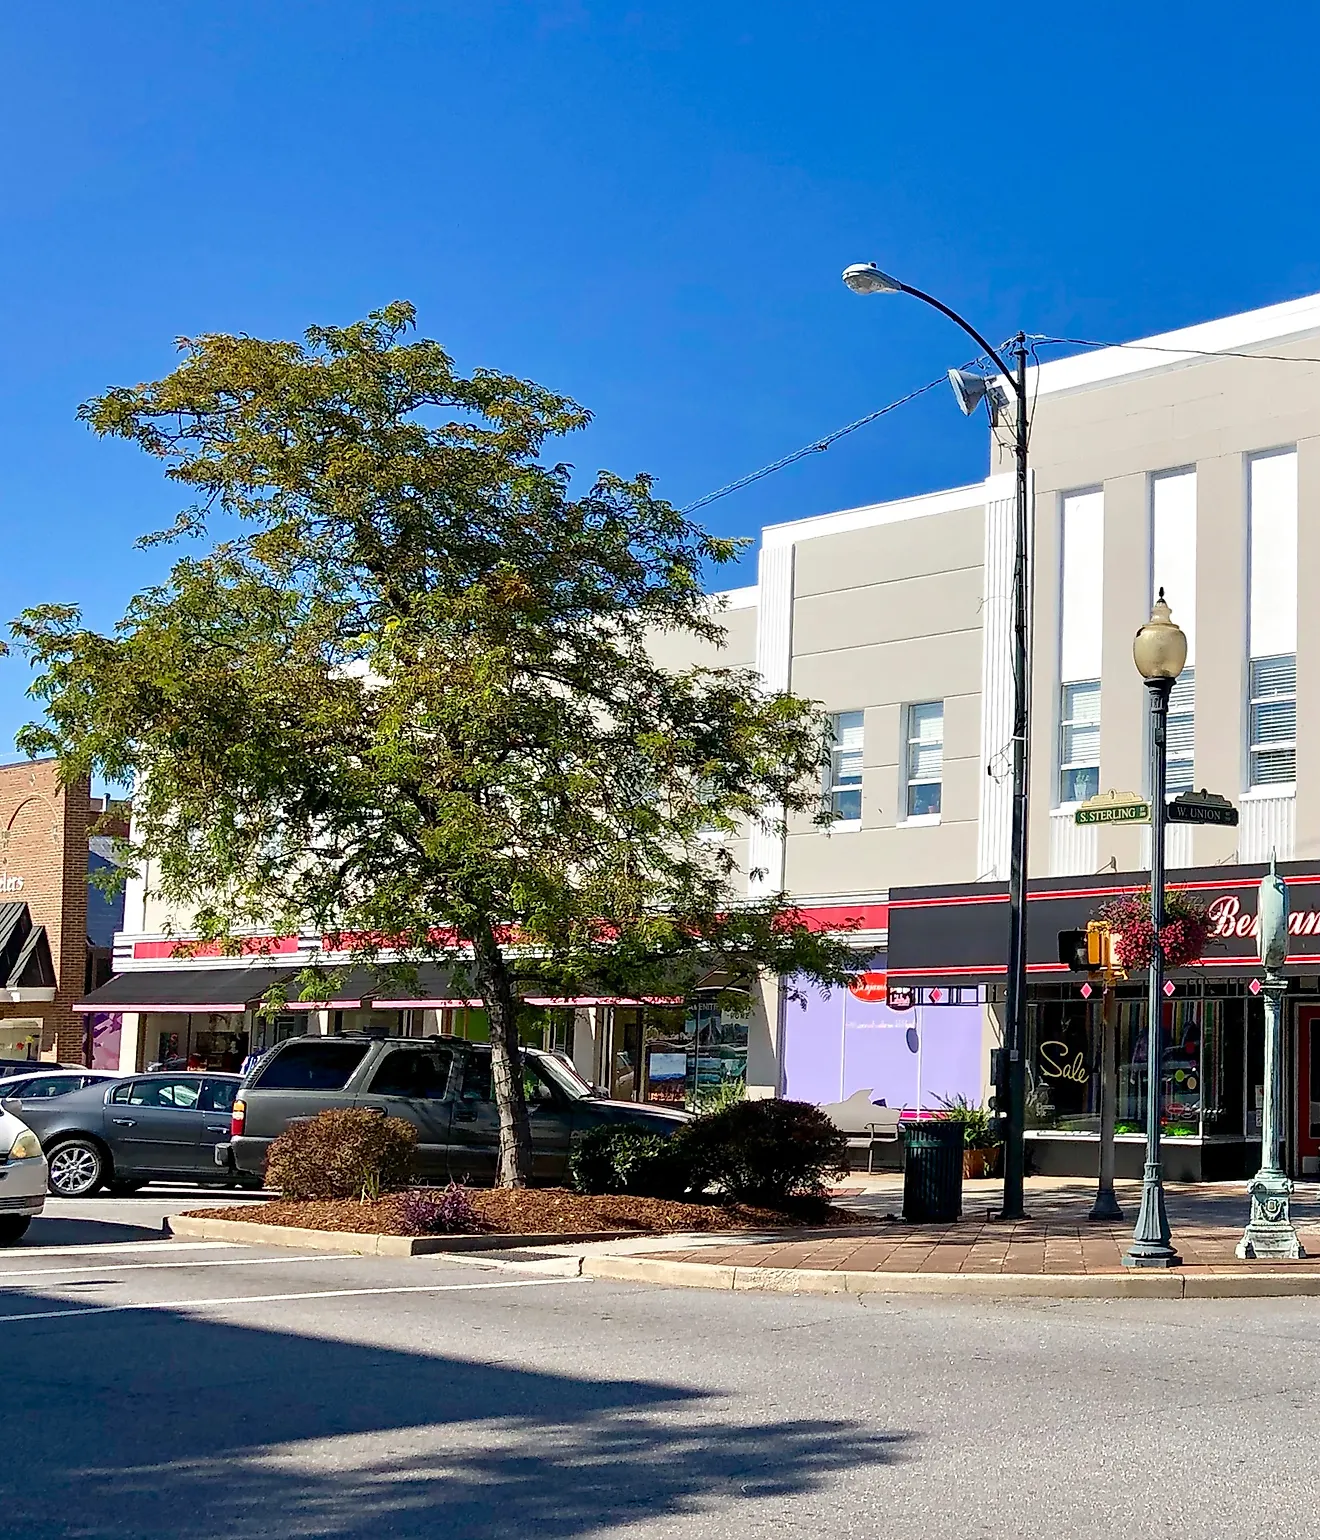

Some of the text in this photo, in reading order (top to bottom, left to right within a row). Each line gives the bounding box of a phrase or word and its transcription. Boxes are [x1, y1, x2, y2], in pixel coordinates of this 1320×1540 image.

[1080, 812, 1088, 822] S.
[1089, 808, 1136, 821] STERLING
[1177, 807, 1187, 817] W.
[1190, 808, 1221, 820] UNION
[1040, 1041, 1090, 1083] Sale
